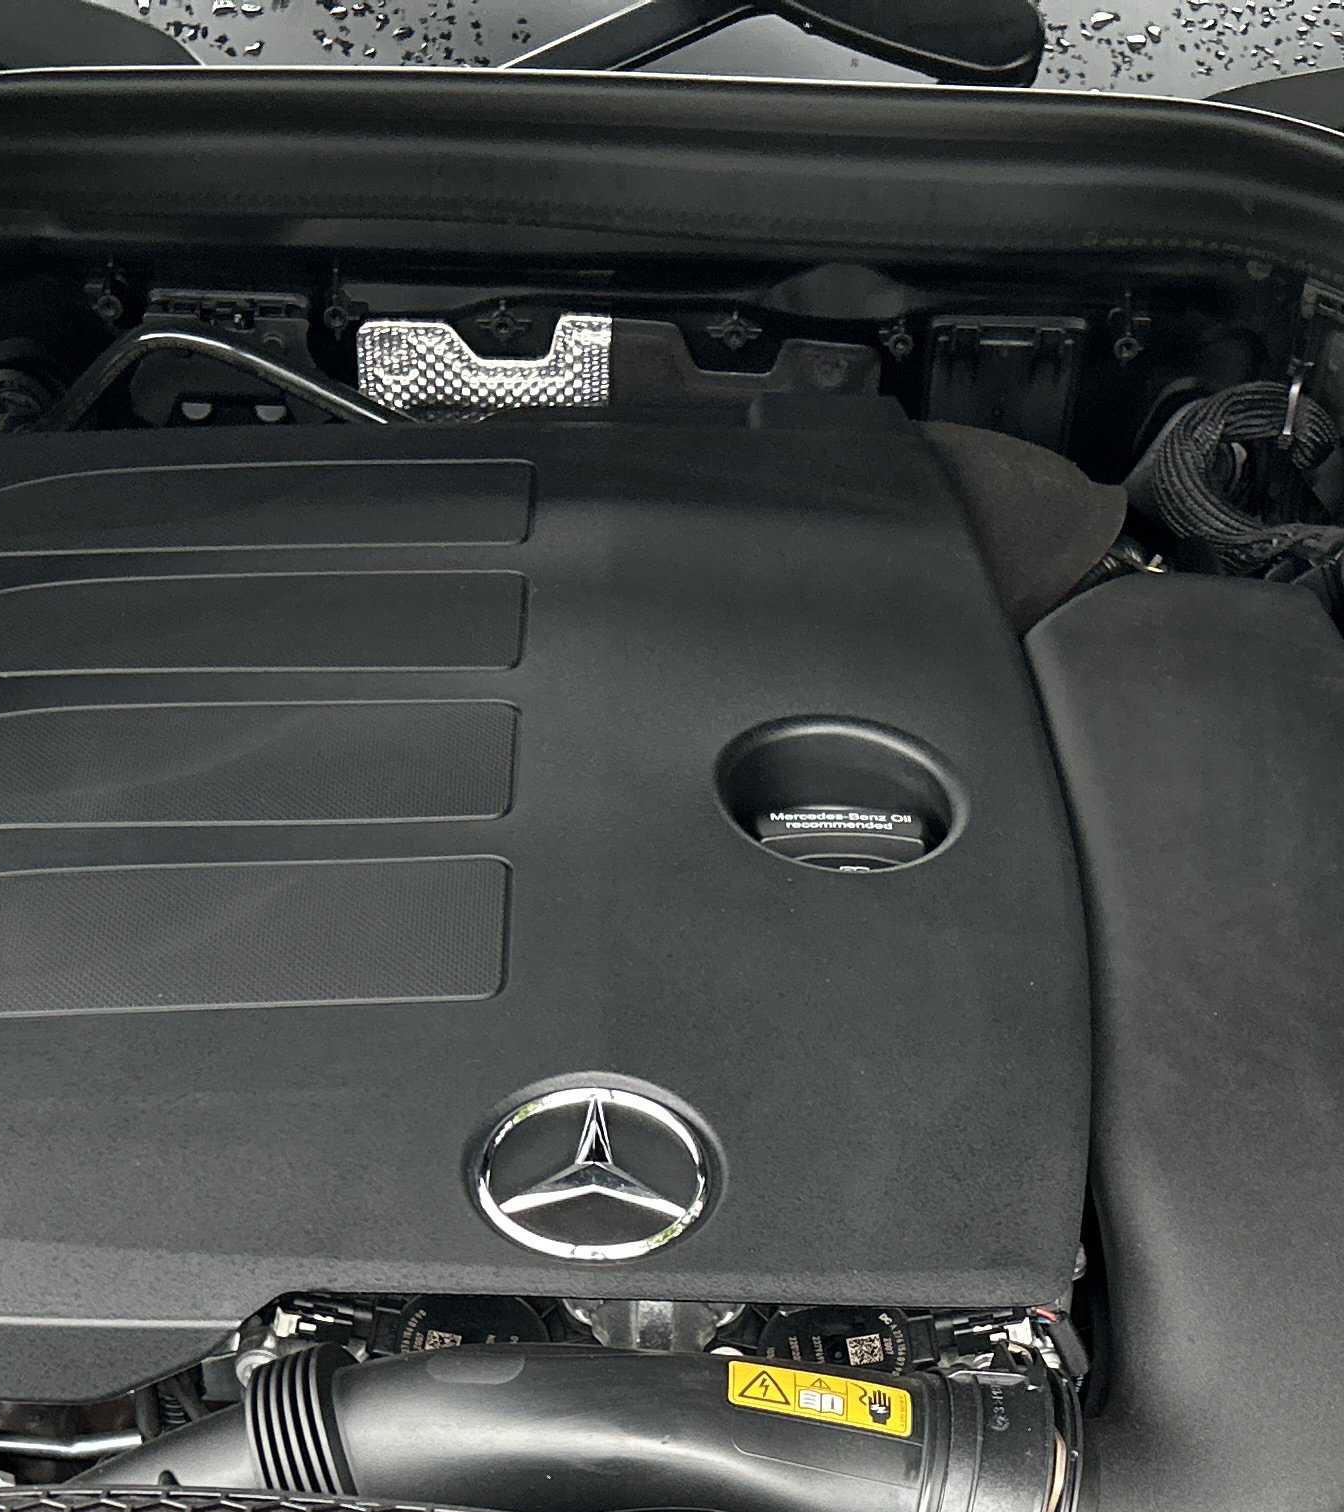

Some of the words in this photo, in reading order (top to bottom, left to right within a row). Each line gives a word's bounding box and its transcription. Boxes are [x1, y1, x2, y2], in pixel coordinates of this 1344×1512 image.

[769, 812, 887, 822] Mercedes-Benz
[890, 814, 912, 823] Oil
[785, 822, 893, 830] recommended
